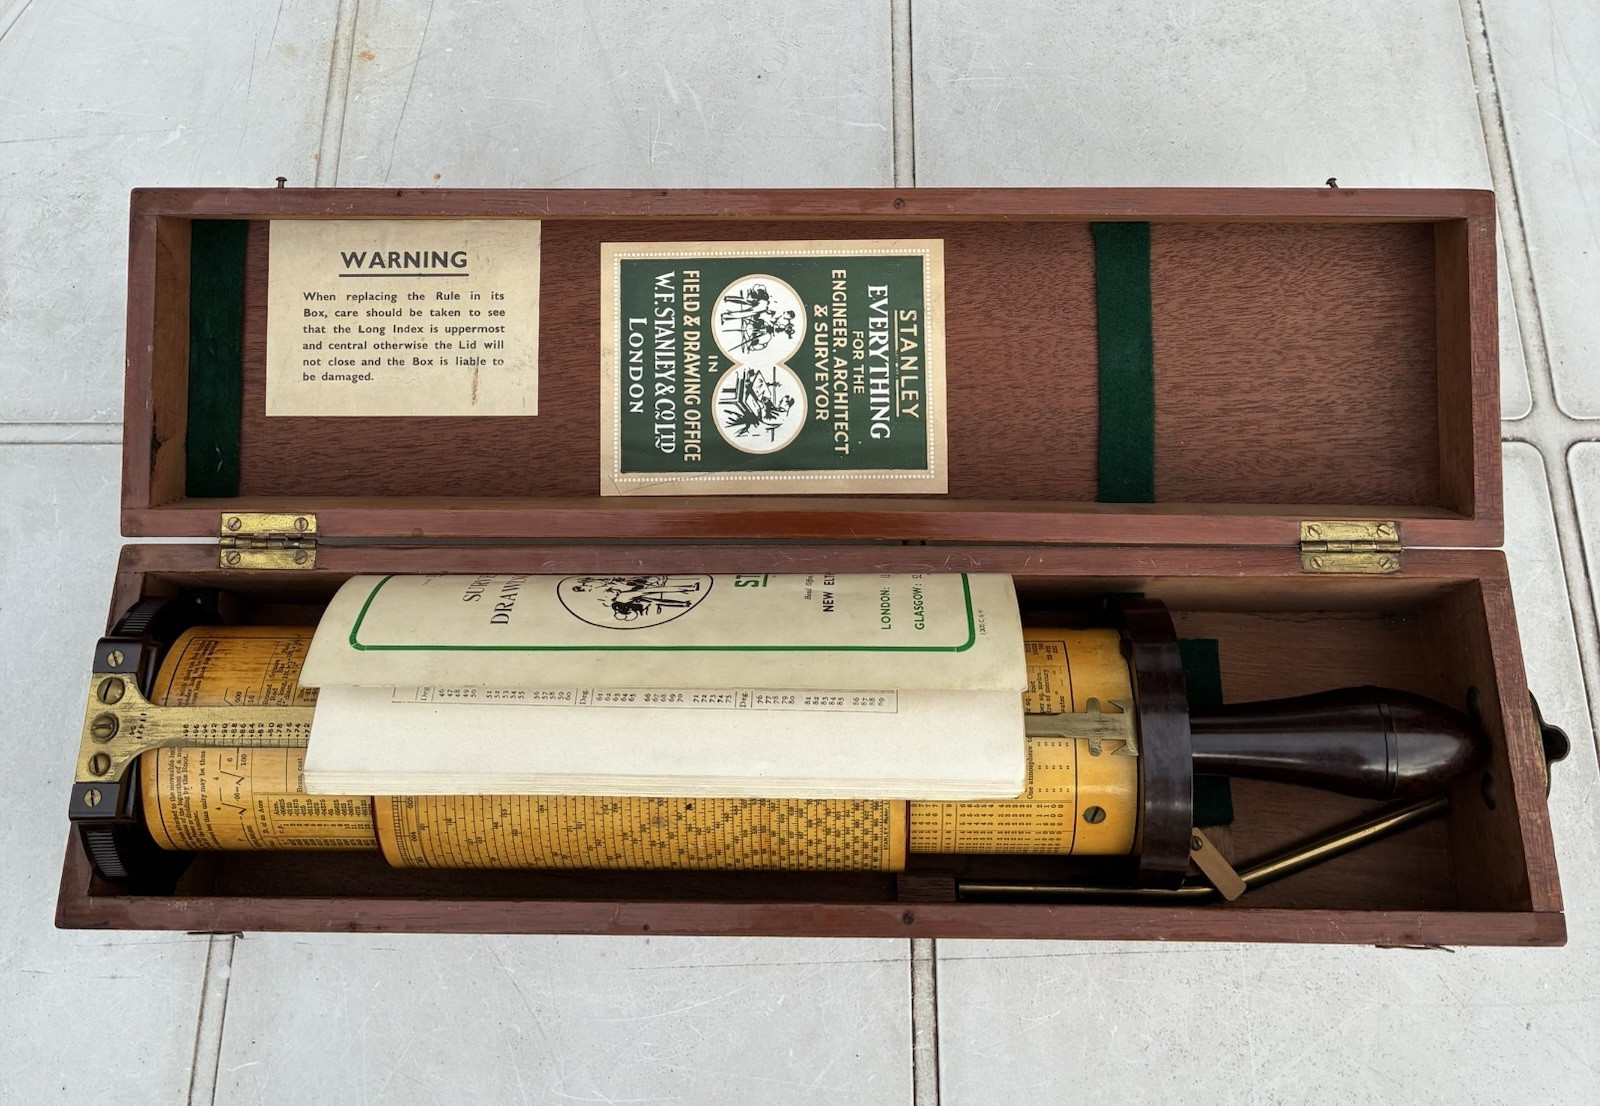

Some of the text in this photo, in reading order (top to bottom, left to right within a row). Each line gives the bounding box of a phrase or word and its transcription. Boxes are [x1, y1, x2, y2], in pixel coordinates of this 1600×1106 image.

[341, 251, 468, 268] WARNING
[303, 291, 504, 303] When replacing the Rule in its
[303, 309, 327, 318] Box,
[366, 308, 402, 317] should
[410, 308, 422, 317] be
[430, 308, 460, 317] taken
[469, 309, 480, 317] to
[303, 325, 505, 335] that the Long Index is uppermost
[303, 341, 504, 350] and central otherwise the Lid will
[328, 358, 355, 366] close
[362, 358, 380, 366] and
[387, 358, 404, 366] the
[413, 358, 433, 366] Box
[440, 358, 448, 366] is
[456, 357, 486, 366] liable
[683, 270, 701, 461] FIELD & DRAWING OFFICE
[707, 355, 718, 372] IN
[814, 304, 828, 420] & SURVEYOR
[853, 331, 864, 393] FOR THE
[867, 285, 890, 439] EVERYTHING
[899, 309, 919, 418] STANLEY
[303, 372, 374, 383] be damaged.
[833, 357, 849, 454] ARCHITECT
[822, 592, 834, 612] NEW
[880, 587, 891, 629] LONDON:
[912, 584, 925, 630] GLASGOW:
[439, 689, 445, 697] 46
[454, 689, 460, 697] 48
[470, 689, 476, 697] 50
[542, 691, 548, 700] 57
[549, 692, 555, 700] 58
[558, 692, 565, 700] 59
[565, 692, 571, 700] 60
[580, 688, 589, 704] Deg.
[596, 693, 603, 701] 61
[604, 693, 611, 701] 62
[612, 693, 620, 701] 63
[644, 693, 651, 702] 66
[628, 694, 636, 702] 65
[652, 694, 660, 702] 67
[660, 694, 666, 702] 68
[668, 694, 676, 702] 69
[676, 694, 683, 702] 70
[717, 695, 724, 703] 74
[725, 695, 732, 703] 75
[739, 691, 748, 707] Deg.
[757, 695, 764, 704] 76
[766, 695, 772, 704] 77
[773, 695, 780, 704] 78
[781, 696, 788, 704] 79
[788, 696, 796, 704] 80
[804, 697, 811, 705] 81
[812, 697, 819, 705] 82
[820, 697, 828, 705] 83
[828, 697, 836, 705] 84
[836, 697, 844, 705] 85
[853, 697, 860, 706] 86
[861, 697, 868, 706] 87
[869, 697, 876, 706] 88
[877, 698, 885, 706] 89
[198, 751, 206, 766] thus
[1026, 746, 1035, 785] atmosphere
